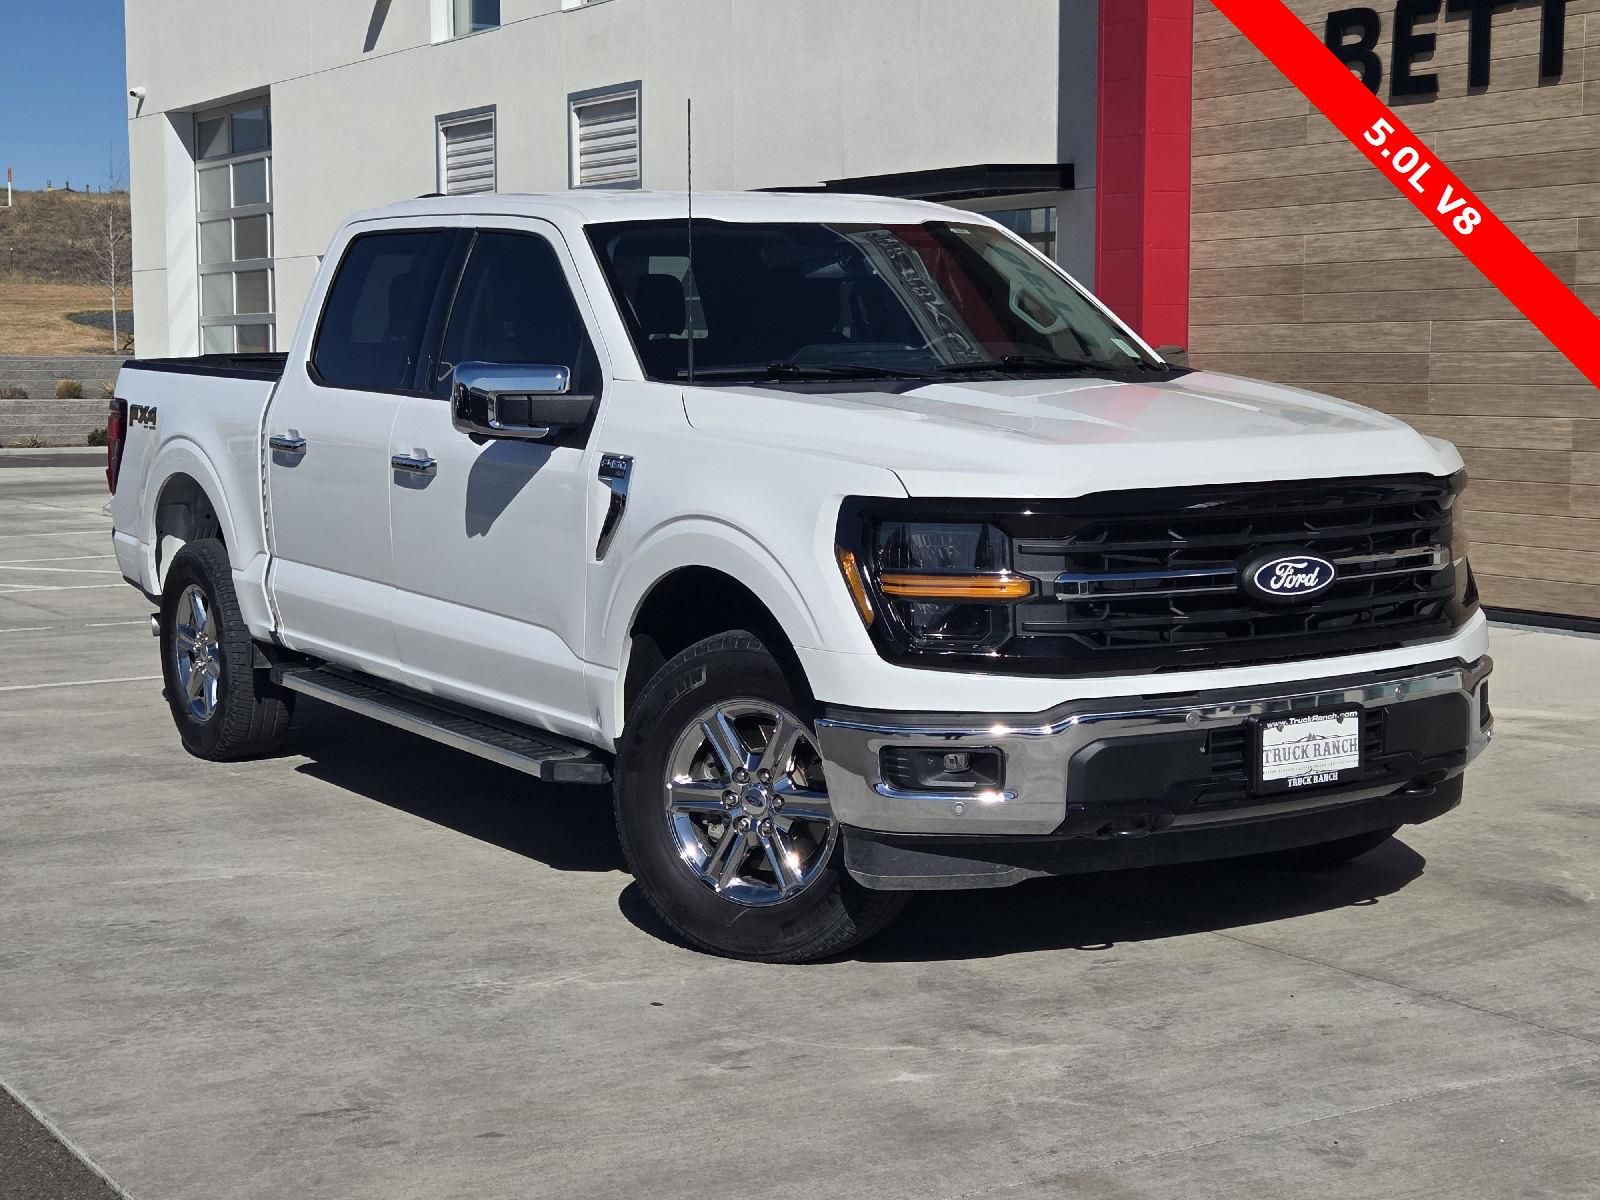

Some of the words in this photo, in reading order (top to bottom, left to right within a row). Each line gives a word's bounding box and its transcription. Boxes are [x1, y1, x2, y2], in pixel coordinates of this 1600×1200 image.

[129, 404, 157, 426] FX4
[1270, 562, 1320, 589] Ford
[1263, 744, 1310, 764] TRUCK
[1313, 738, 1358, 758] RANCH
[1287, 775, 1312, 788] TRUCK
[1313, 771, 1338, 784] RANCH
